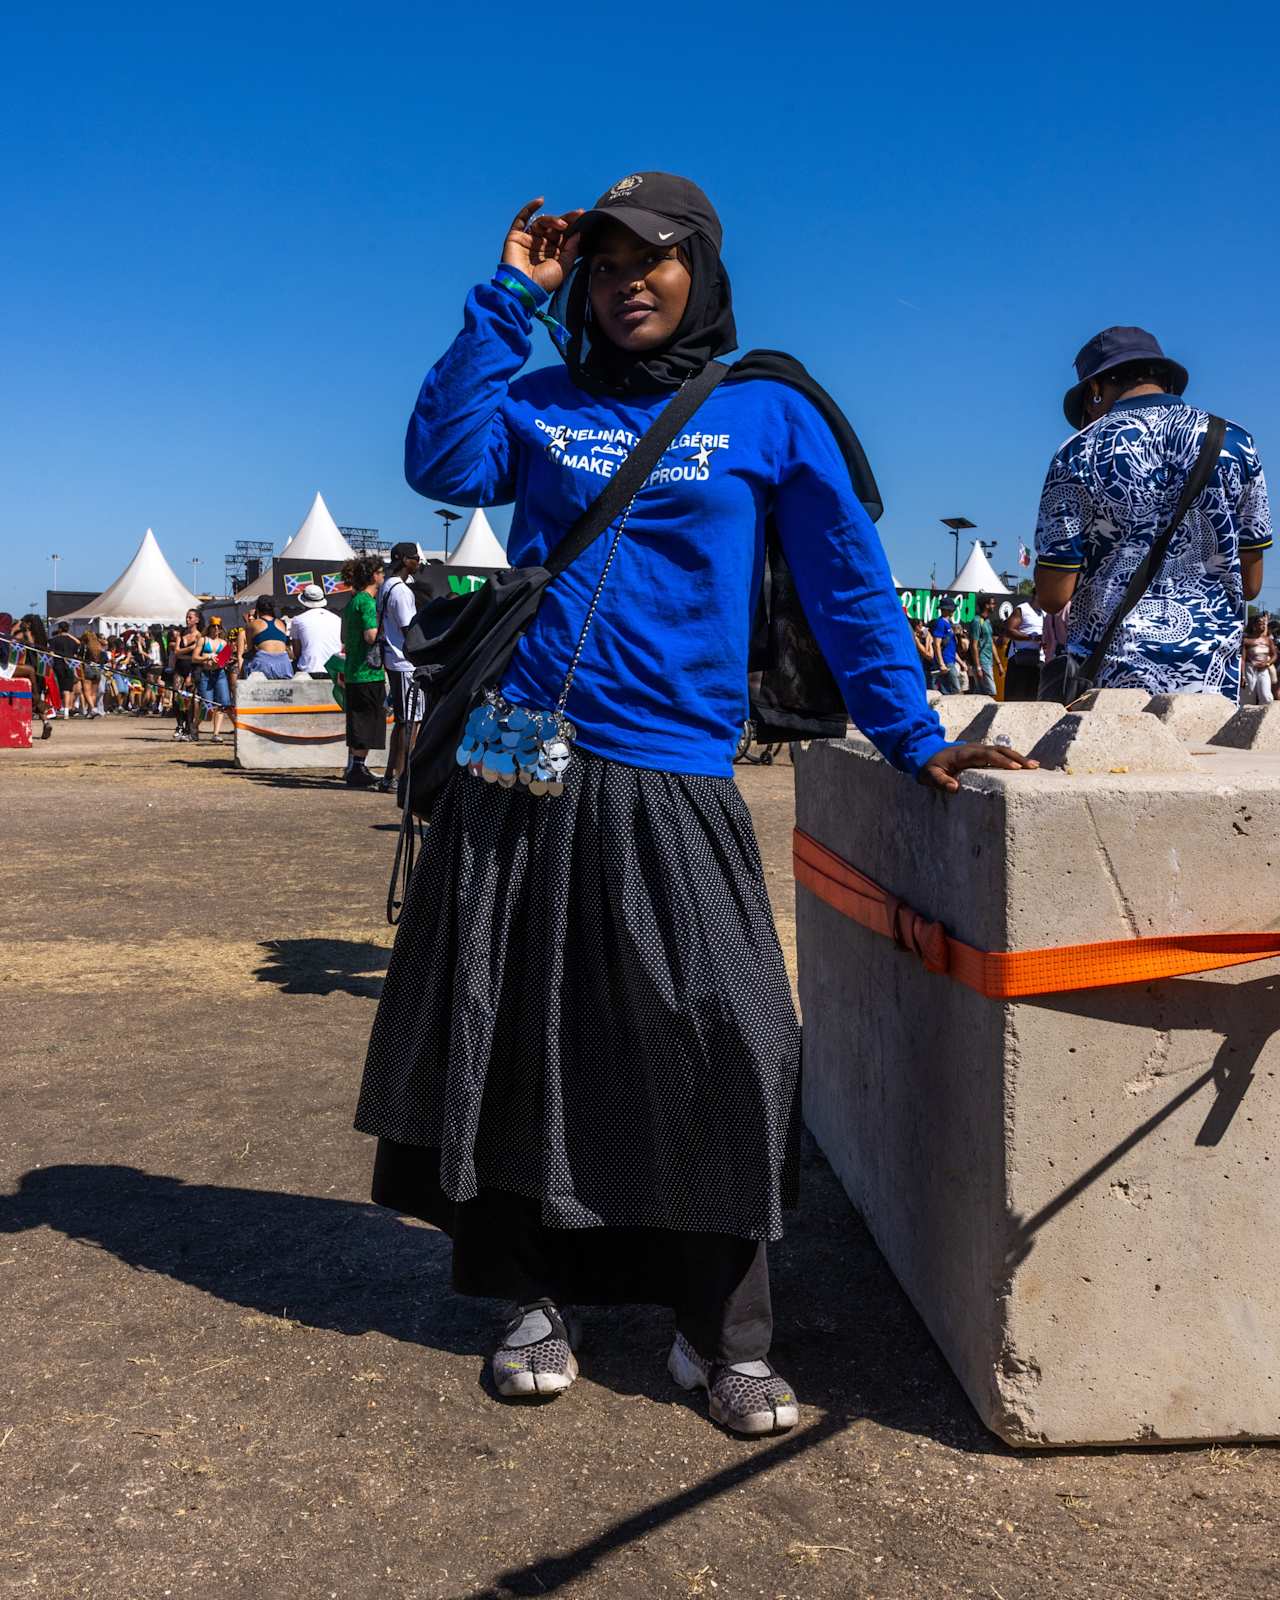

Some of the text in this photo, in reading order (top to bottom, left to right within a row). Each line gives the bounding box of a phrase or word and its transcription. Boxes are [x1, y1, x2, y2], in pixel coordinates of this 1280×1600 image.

[667, 432, 730, 450] LGÉRIE
[562, 454, 614, 478] MAKE
[650, 466, 710, 486] PROUD
